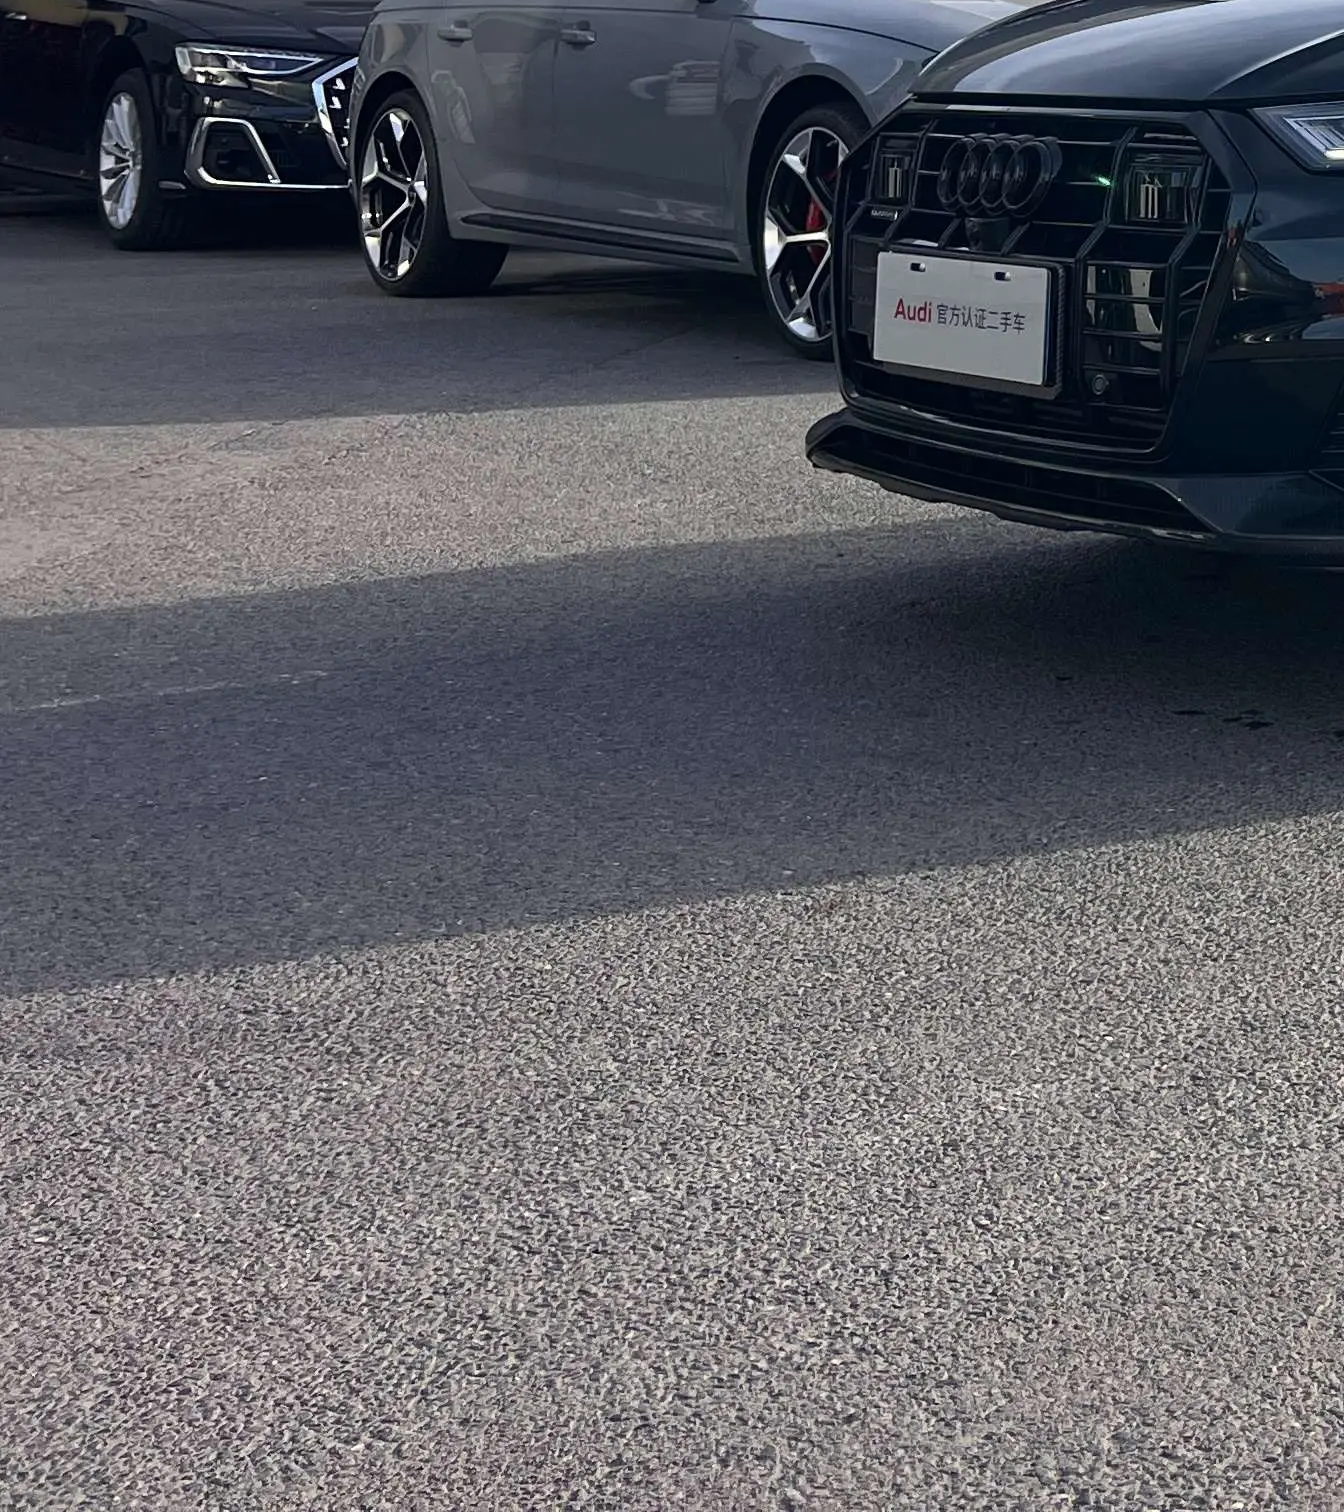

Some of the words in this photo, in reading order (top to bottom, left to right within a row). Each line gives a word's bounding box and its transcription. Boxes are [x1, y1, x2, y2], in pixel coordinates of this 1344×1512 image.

[894, 297, 932, 323] Audi
[936, 304, 1026, 334] 官方认证二手车
